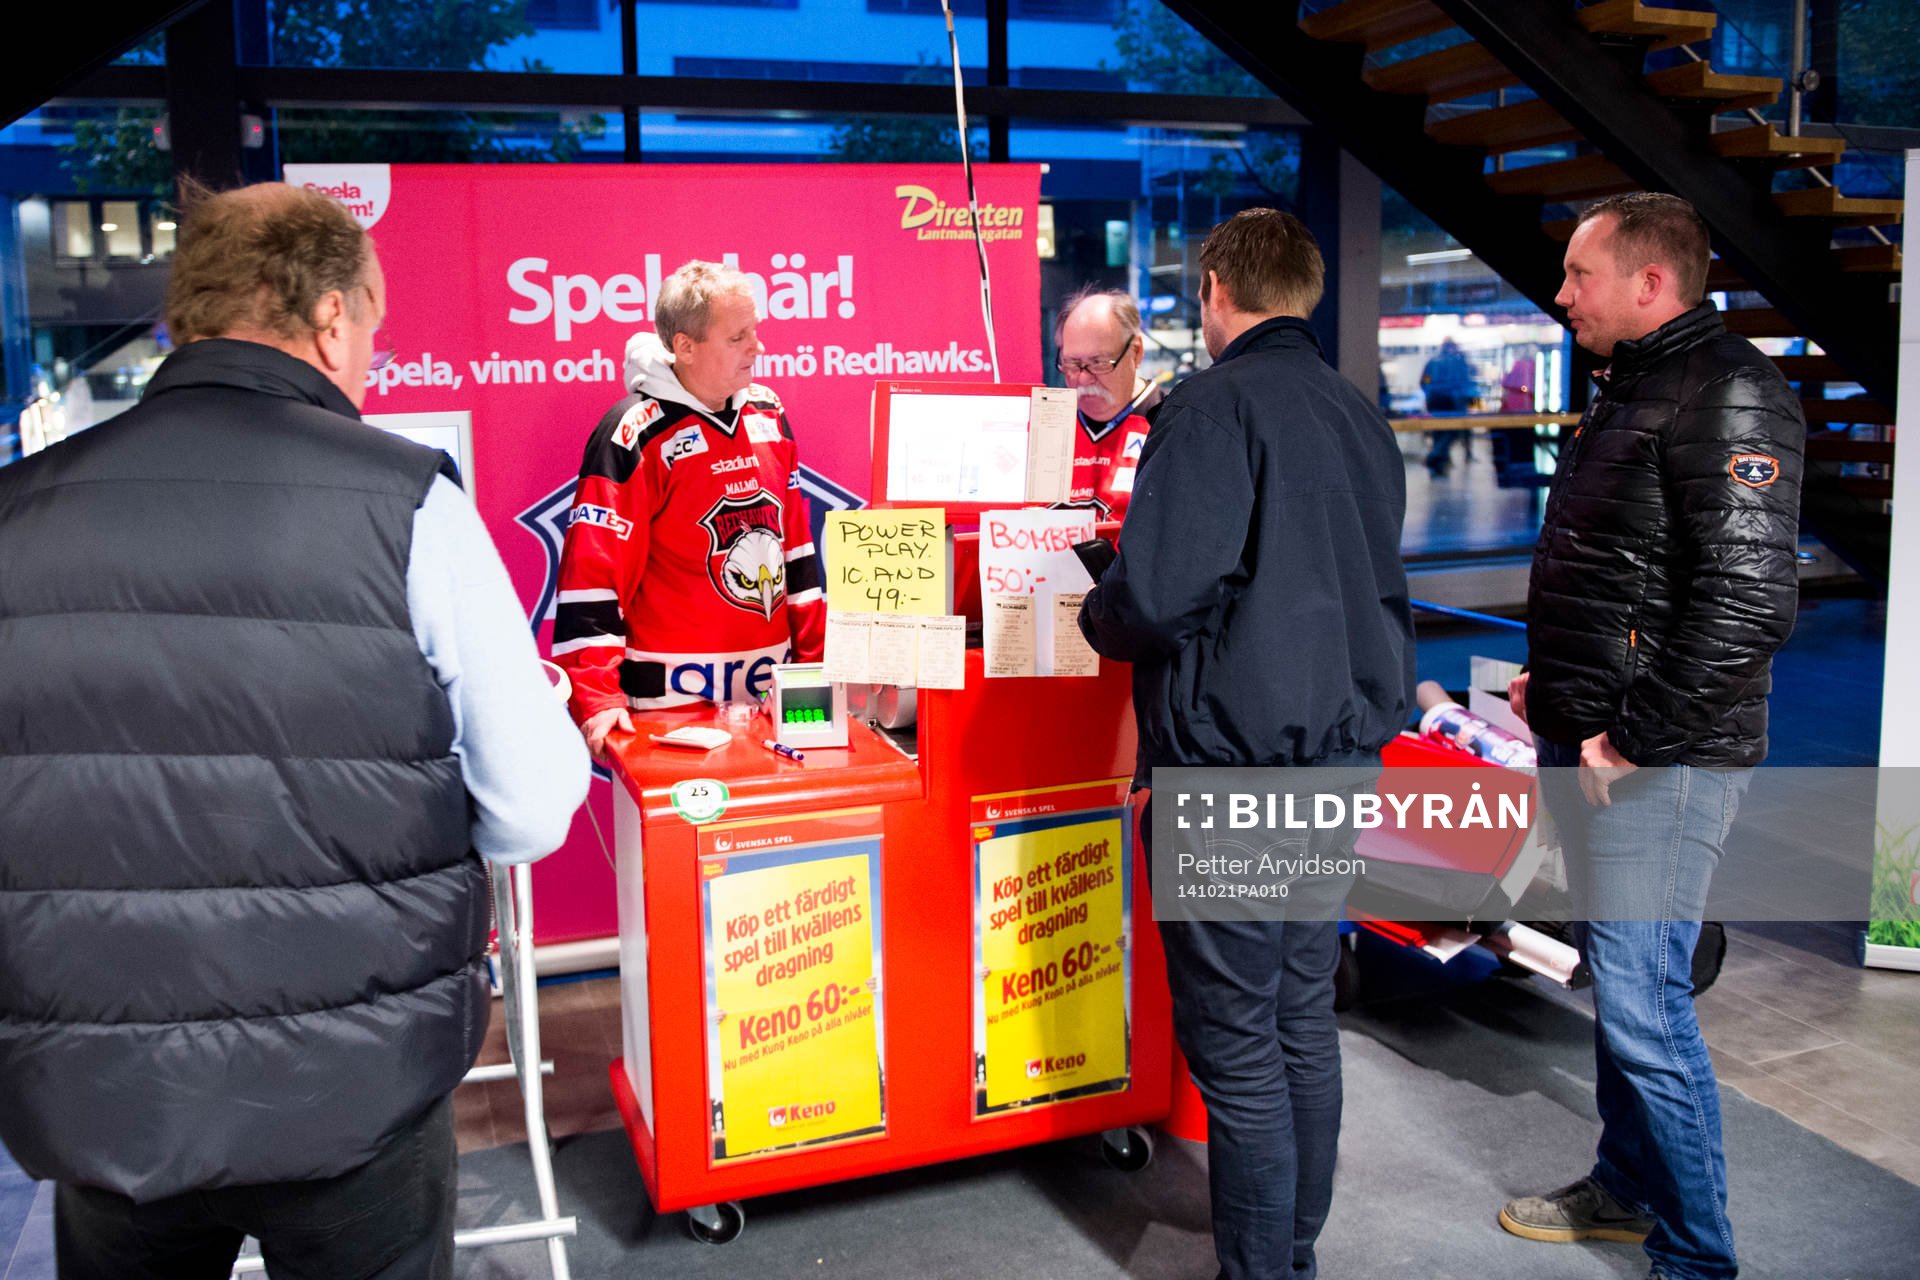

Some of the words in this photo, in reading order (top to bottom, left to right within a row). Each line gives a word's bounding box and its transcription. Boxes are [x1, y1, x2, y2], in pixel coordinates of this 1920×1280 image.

[506, 253, 661, 341] Spel
[470, 352, 546, 385] vinn
[553, 349, 616, 383] och
[823, 342, 992, 376] Redhawks.
[711, 453, 760, 475] stadium
[838, 520, 937, 543] POWER
[670, 648, 791, 701] are
[690, 785, 710, 797] 25
[1004, 807, 1037, 817] SVENSKA
[1038, 804, 1056, 812] SPEL
[735, 838, 773, 849] SVENSKA
[774, 835, 795, 845] SPEL
[993, 875, 1023, 902] Köp
[1027, 862, 1051, 888] ett
[1055, 838, 1110, 877] färdigt
[726, 914, 760, 943] Köp
[764, 900, 791, 927] ett
[795, 875, 856, 916] färdigt
[990, 899, 1022, 930] spel
[1026, 889, 1048, 915] till
[1051, 866, 1114, 906] kvällens
[724, 939, 760, 973] spel
[764, 928, 788, 956] till
[791, 904, 862, 946] kvällens
[1018, 902, 1088, 944] dragning
[756, 942, 834, 988] dragning
[1002, 961, 1058, 1005] Keno
[1062, 941, 1111, 978] 60:-
[739, 1004, 801, 1049] Keno
[807, 983, 861, 1021] 60:-
[1001, 1005, 1019, 1019] med
[1021, 996, 1042, 1012] Kung
[1044, 987, 1064, 1002] Keno
[1066, 979, 1077, 994] på
[1078, 974, 1093, 987] alla
[724, 1060, 737, 1072] Nu
[739, 1052, 760, 1066] med
[762, 1041, 785, 1056] Kung
[788, 1031, 810, 1046] Keno
[811, 1022, 823, 1038] på
[825, 1018, 842, 1031] alla
[844, 1005, 872, 1023] nivåer
[1045, 1052, 1086, 1073] Keno
[790, 1100, 836, 1121] Keno
